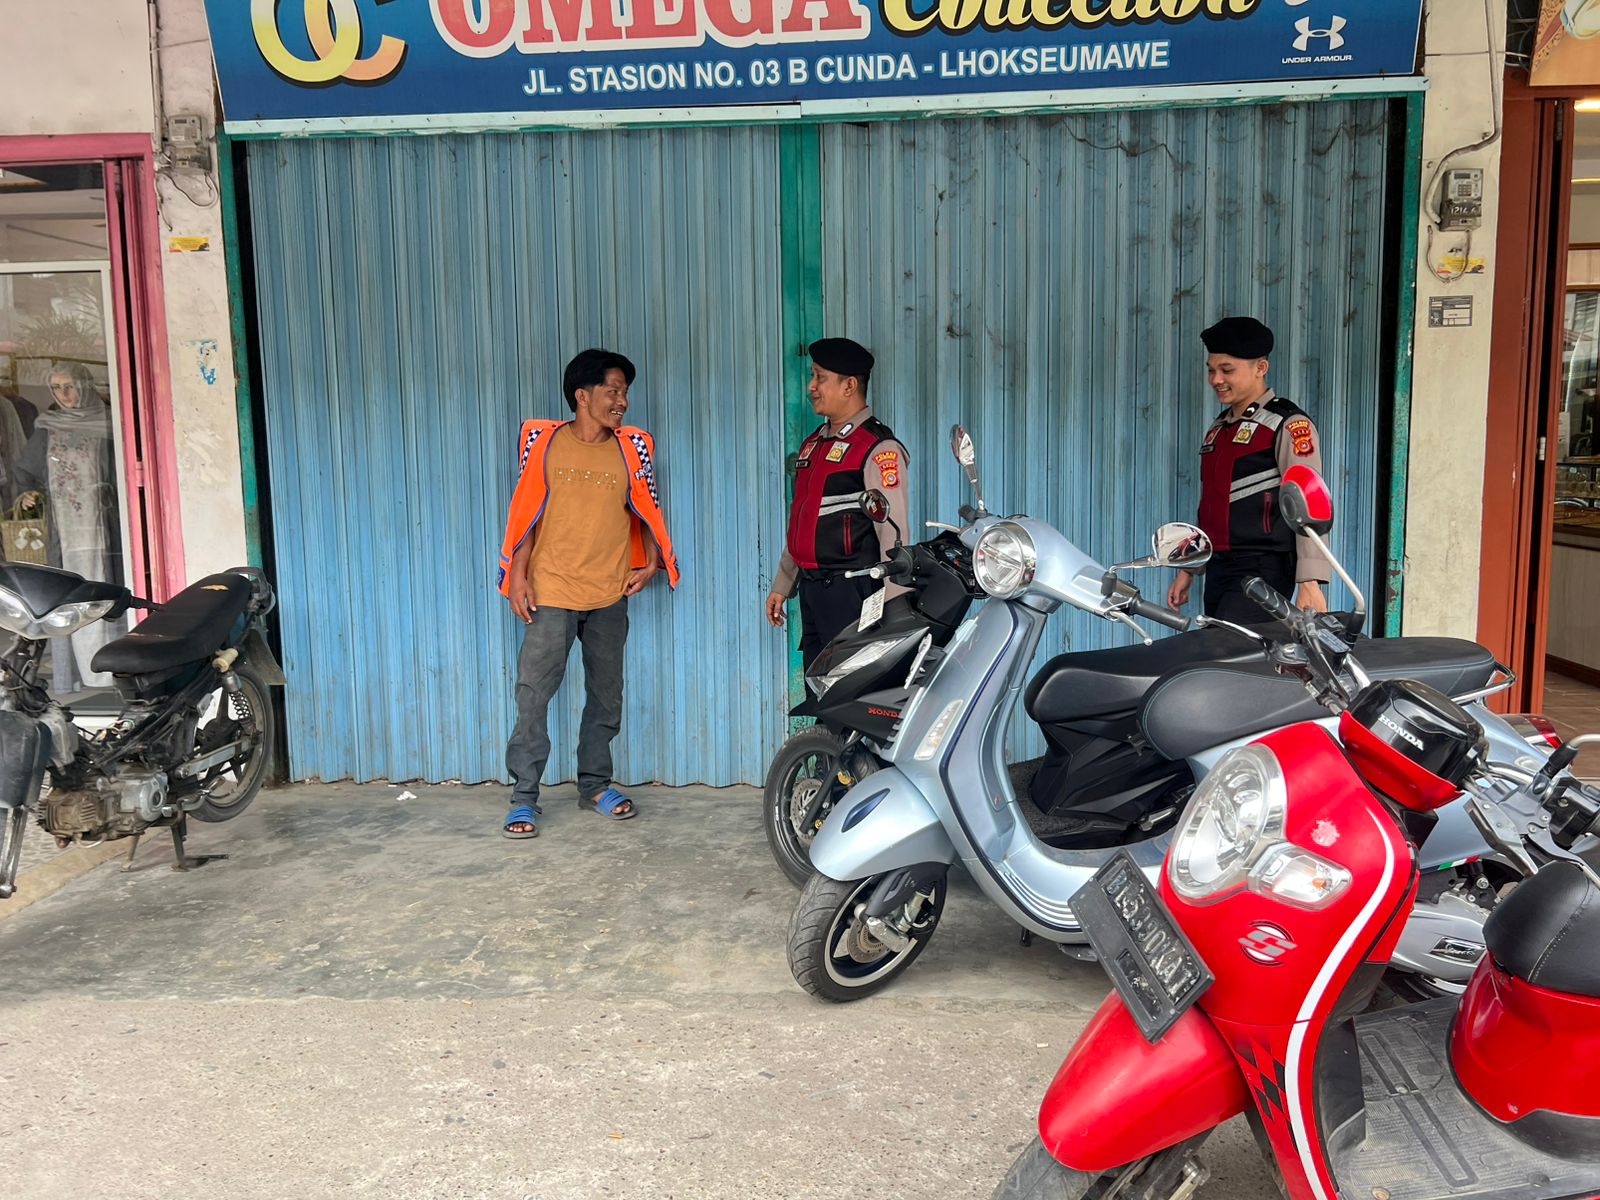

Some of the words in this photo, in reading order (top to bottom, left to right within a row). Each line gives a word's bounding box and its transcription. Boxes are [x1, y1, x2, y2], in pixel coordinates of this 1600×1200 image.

[523, 69, 562, 94] JL.
[570, 63, 686, 93] STASION
[694, 60, 742, 88] NO.
[750, 59, 780, 86] 03
[789, 58, 808, 84] B
[816, 53, 917, 83] CUNDA
[940, 41, 1169, 77] LHOKSEUMAWE
[1281, 56, 1311, 64] UNDER
[1314, 54, 1352, 62] ARMOUR
[868, 707, 901, 719] HOND
[1378, 714, 1424, 751] HONDA
